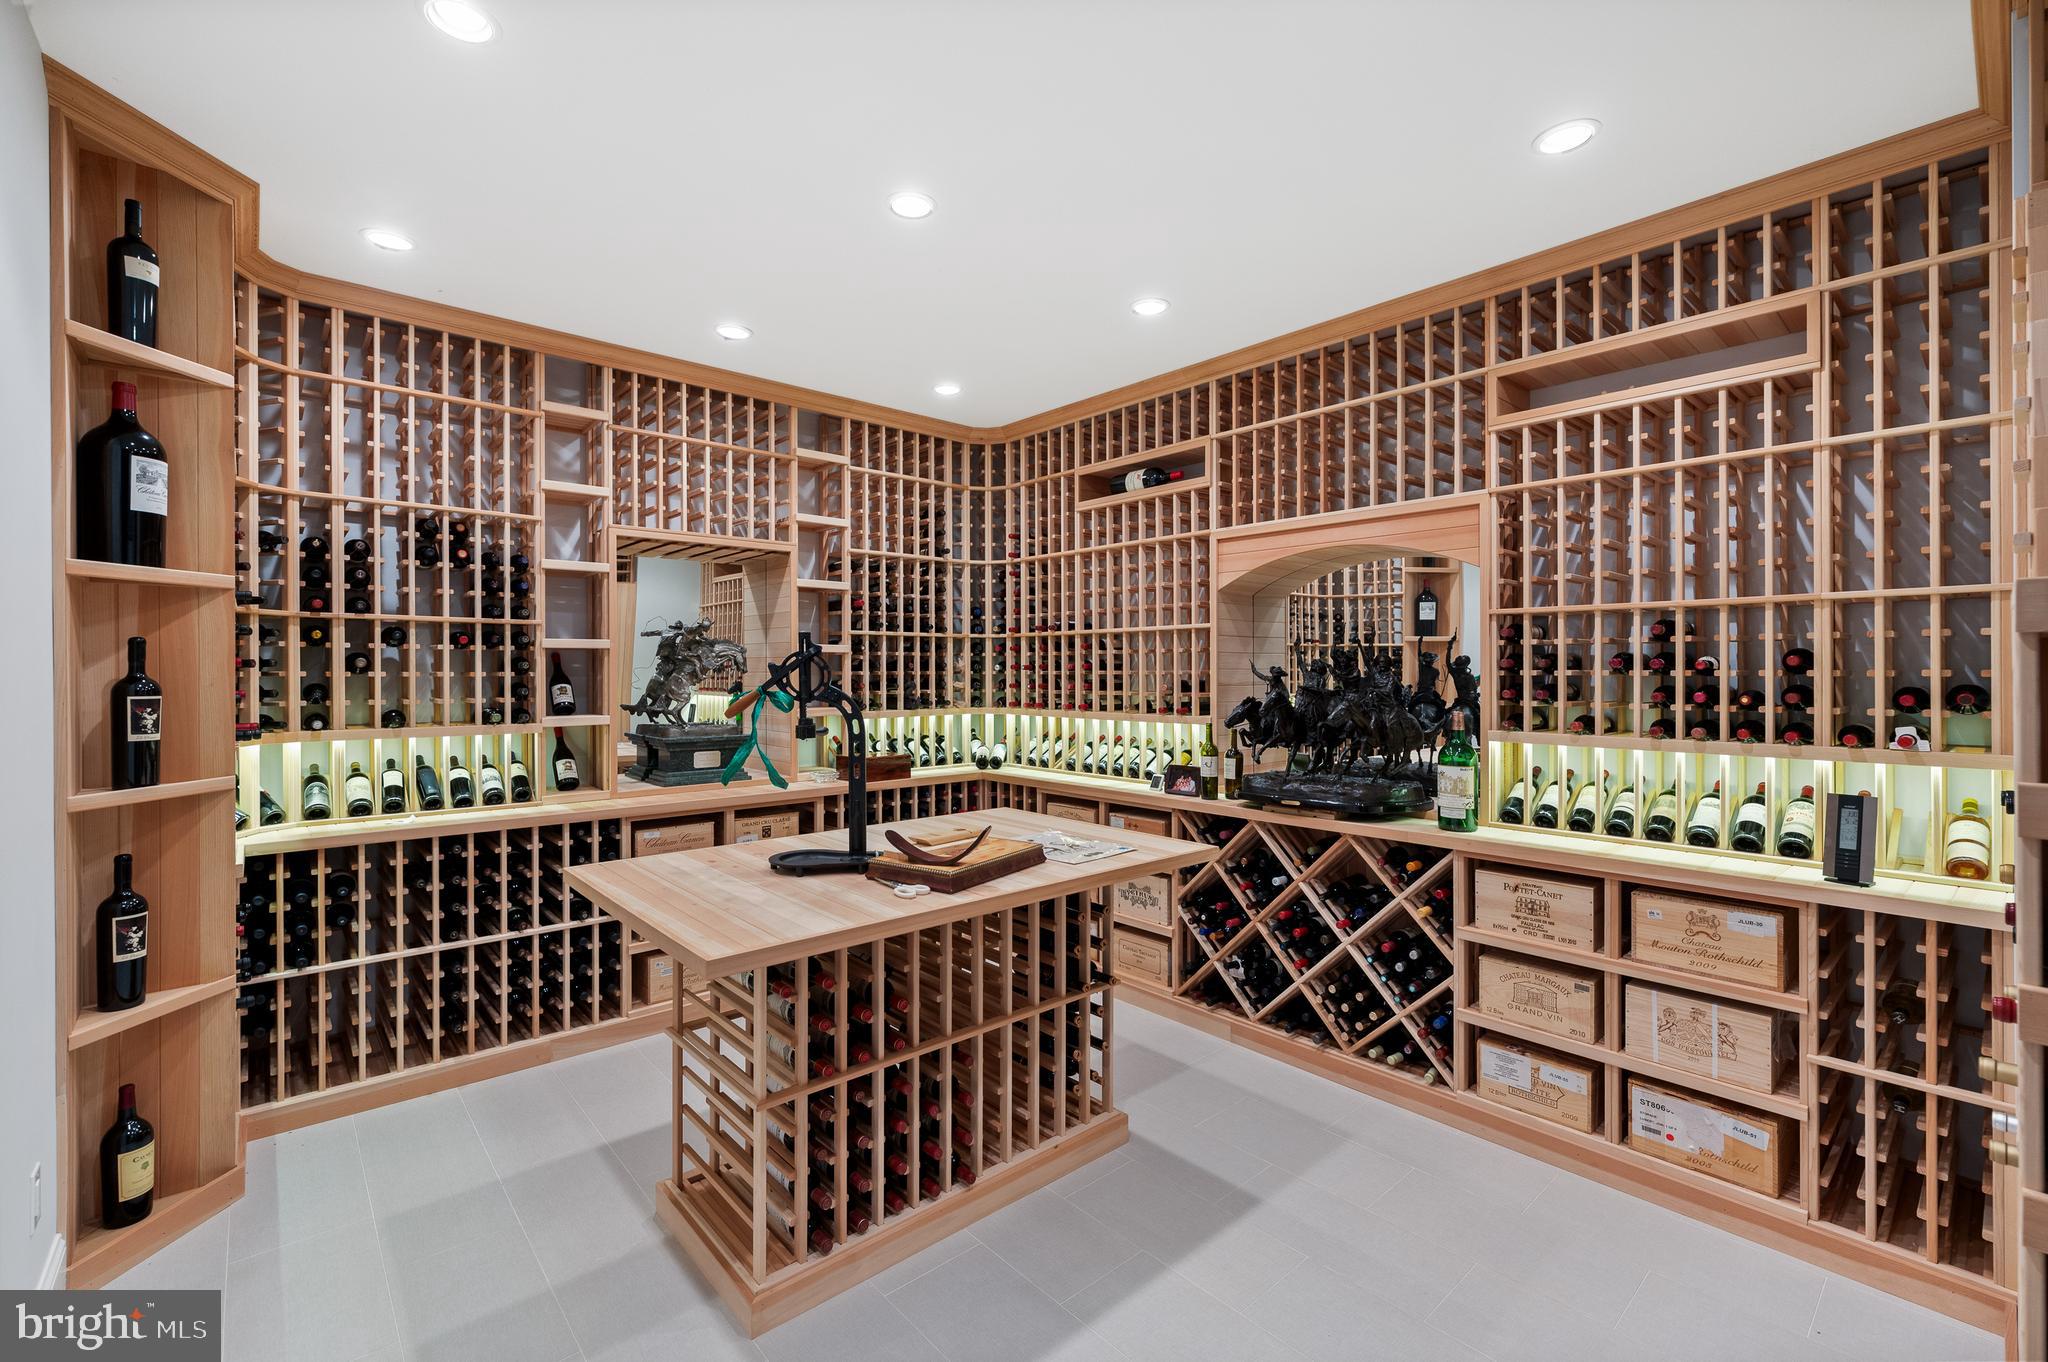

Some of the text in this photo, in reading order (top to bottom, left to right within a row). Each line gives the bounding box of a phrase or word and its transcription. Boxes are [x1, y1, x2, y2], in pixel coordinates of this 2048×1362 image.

[1521, 921, 1544, 929] PAUILLAC
[1689, 960, 1717, 971] 2009
[1500, 972, 1572, 997] CHATEAU MARGAUX
[1507, 1003, 1563, 1023] GRAND VIN
[1569, 1028, 1586, 1038] 2010
[1541, 1080, 1556, 1090] VIN
[1511, 1087, 1556, 1107] ROTHSCHILD
